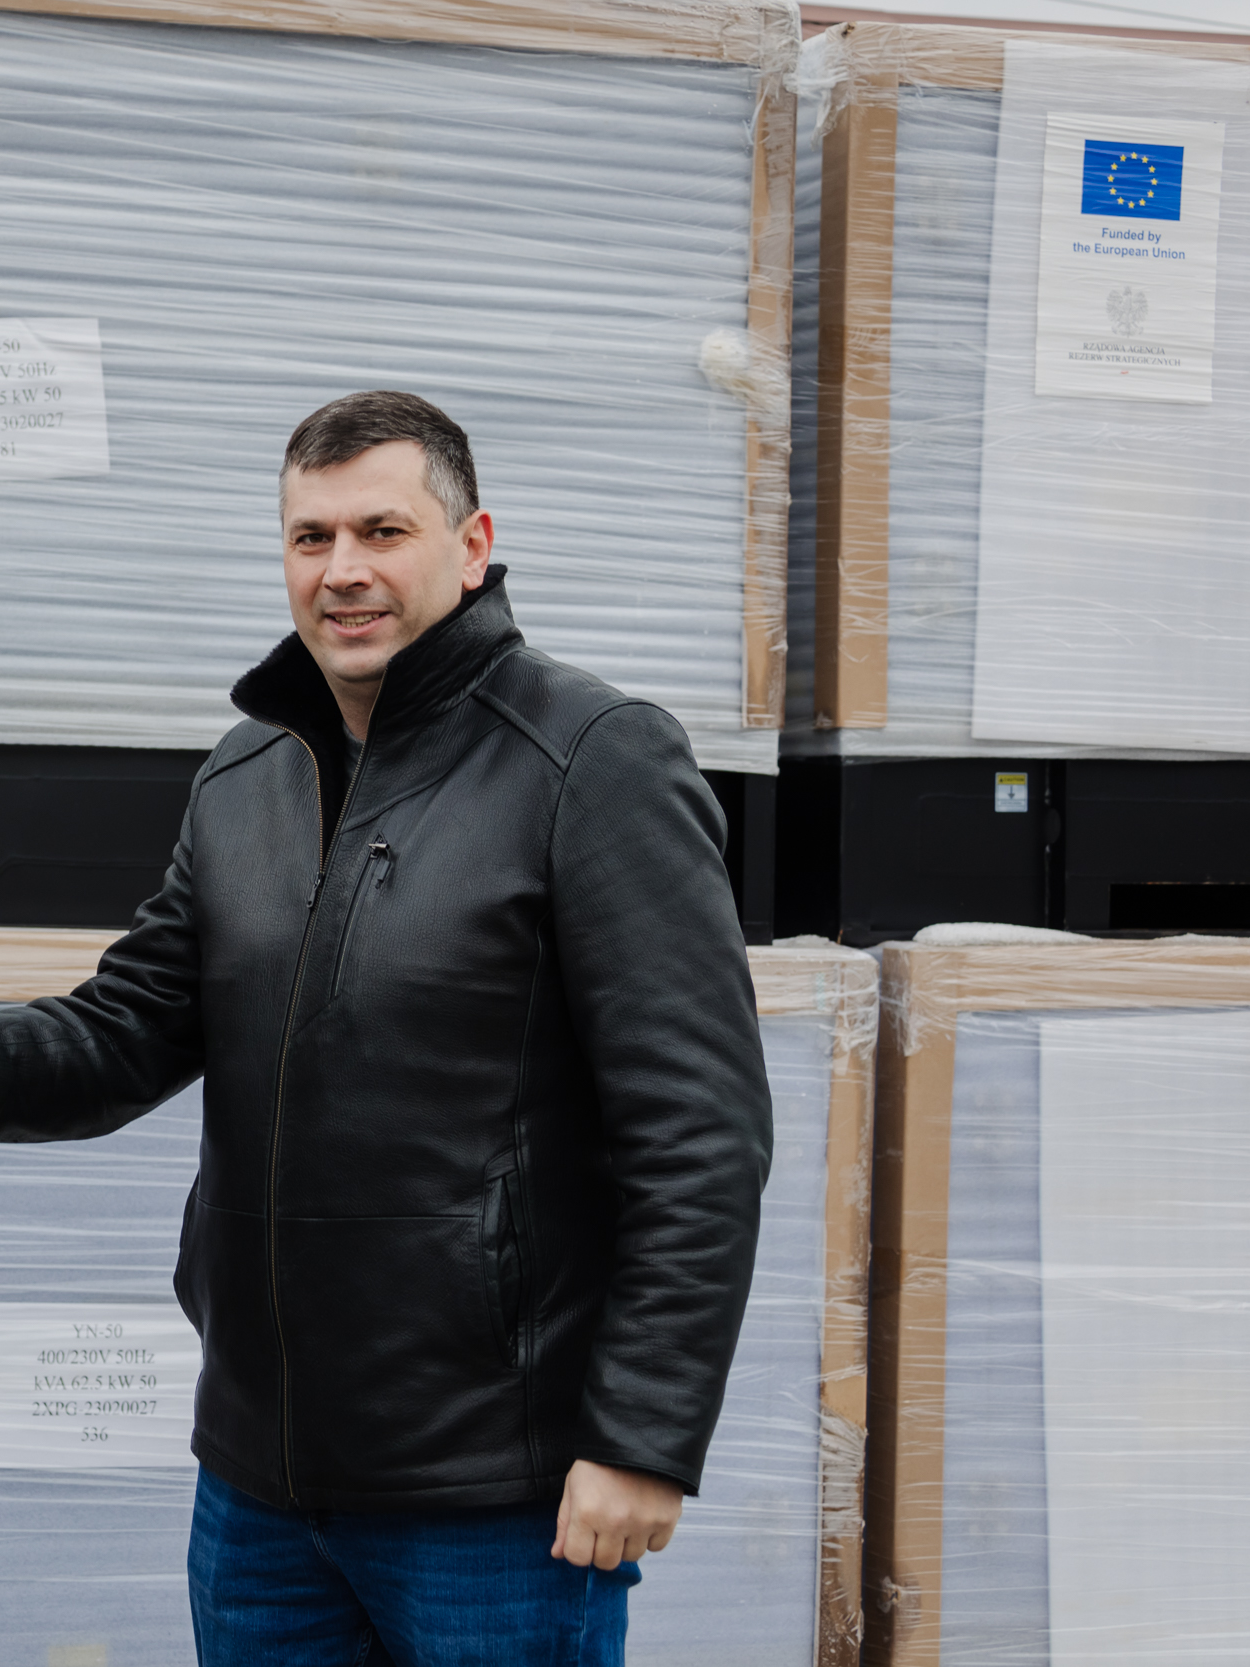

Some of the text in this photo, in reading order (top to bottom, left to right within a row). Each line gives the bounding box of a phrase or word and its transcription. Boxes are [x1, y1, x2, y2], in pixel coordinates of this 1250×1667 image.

[1102, 228, 1161, 244] Funded by
[1073, 242, 1185, 260] the European Union
[1068, 352, 1103, 361] REZERW
[18, 362, 57, 378] 50Hz
[13, 389, 38, 405] kW
[44, 387, 61, 400] 50
[72, 1323, 123, 1339] YN-50
[37, 1350, 155, 1364] 400/230V 50Hz
[34, 1375, 157, 1391] kVA 62.5 kW 50
[32, 1401, 157, 1416] 2XPG-23020027
[81, 1427, 108, 1442] 536
